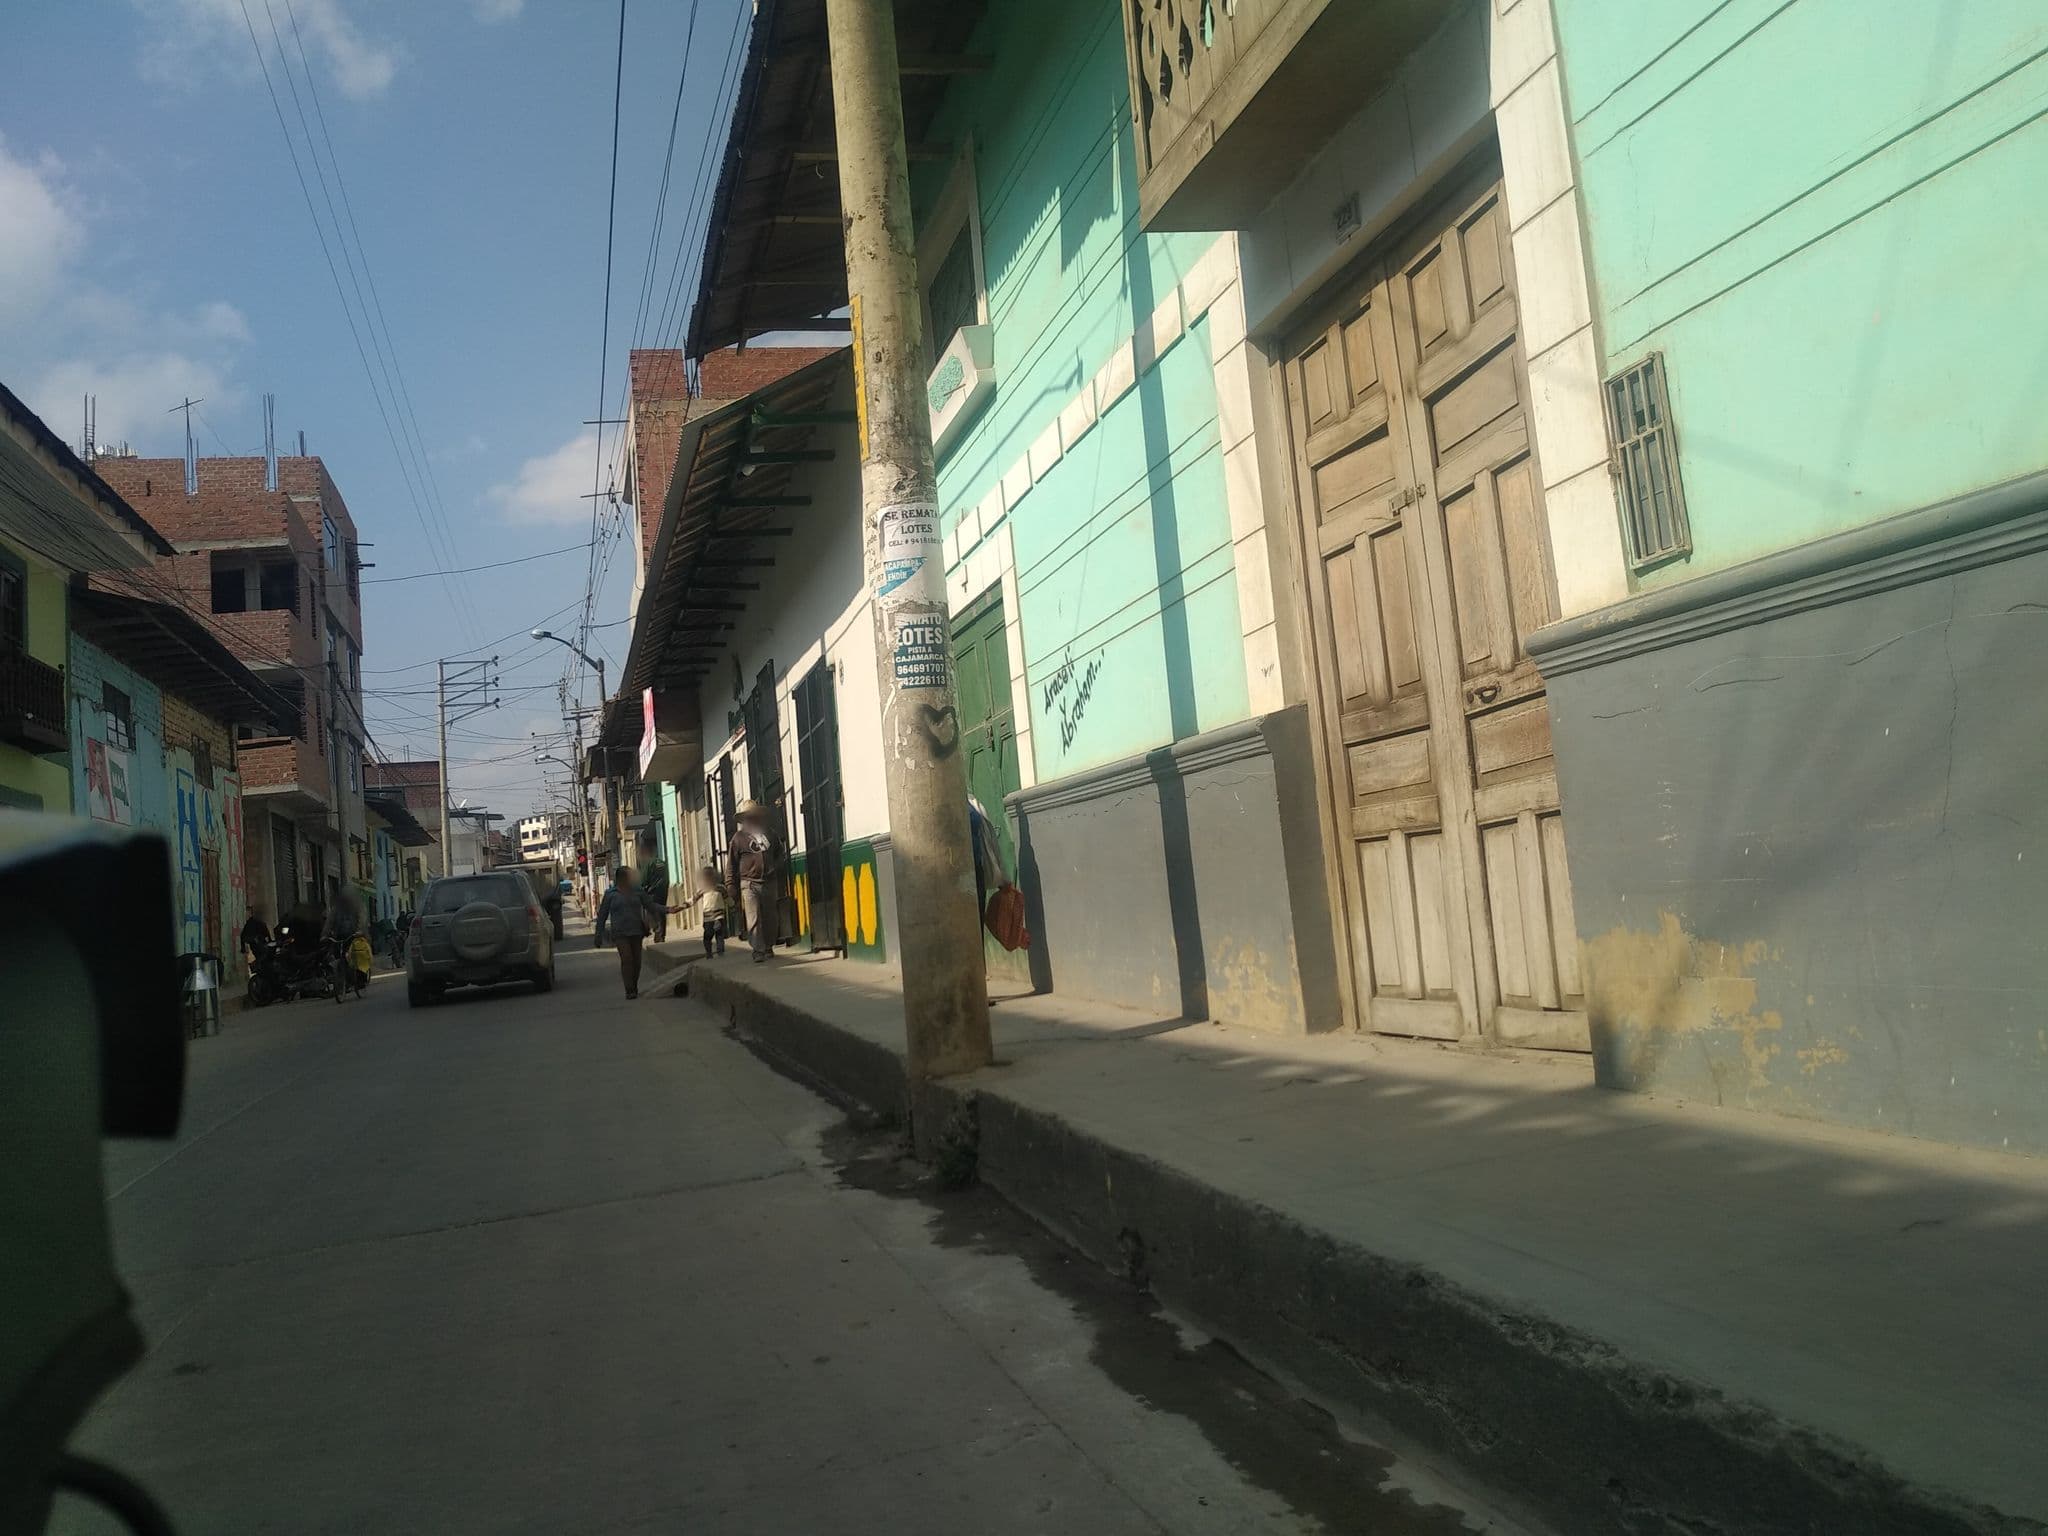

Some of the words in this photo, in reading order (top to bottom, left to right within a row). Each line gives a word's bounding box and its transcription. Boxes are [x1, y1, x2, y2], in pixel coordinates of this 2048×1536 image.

[884, 511, 899, 521] SE
[901, 524, 933, 534] LOTES
[908, 646, 927, 654] PISTA
[896, 653, 945, 663] CAJAMARCA
